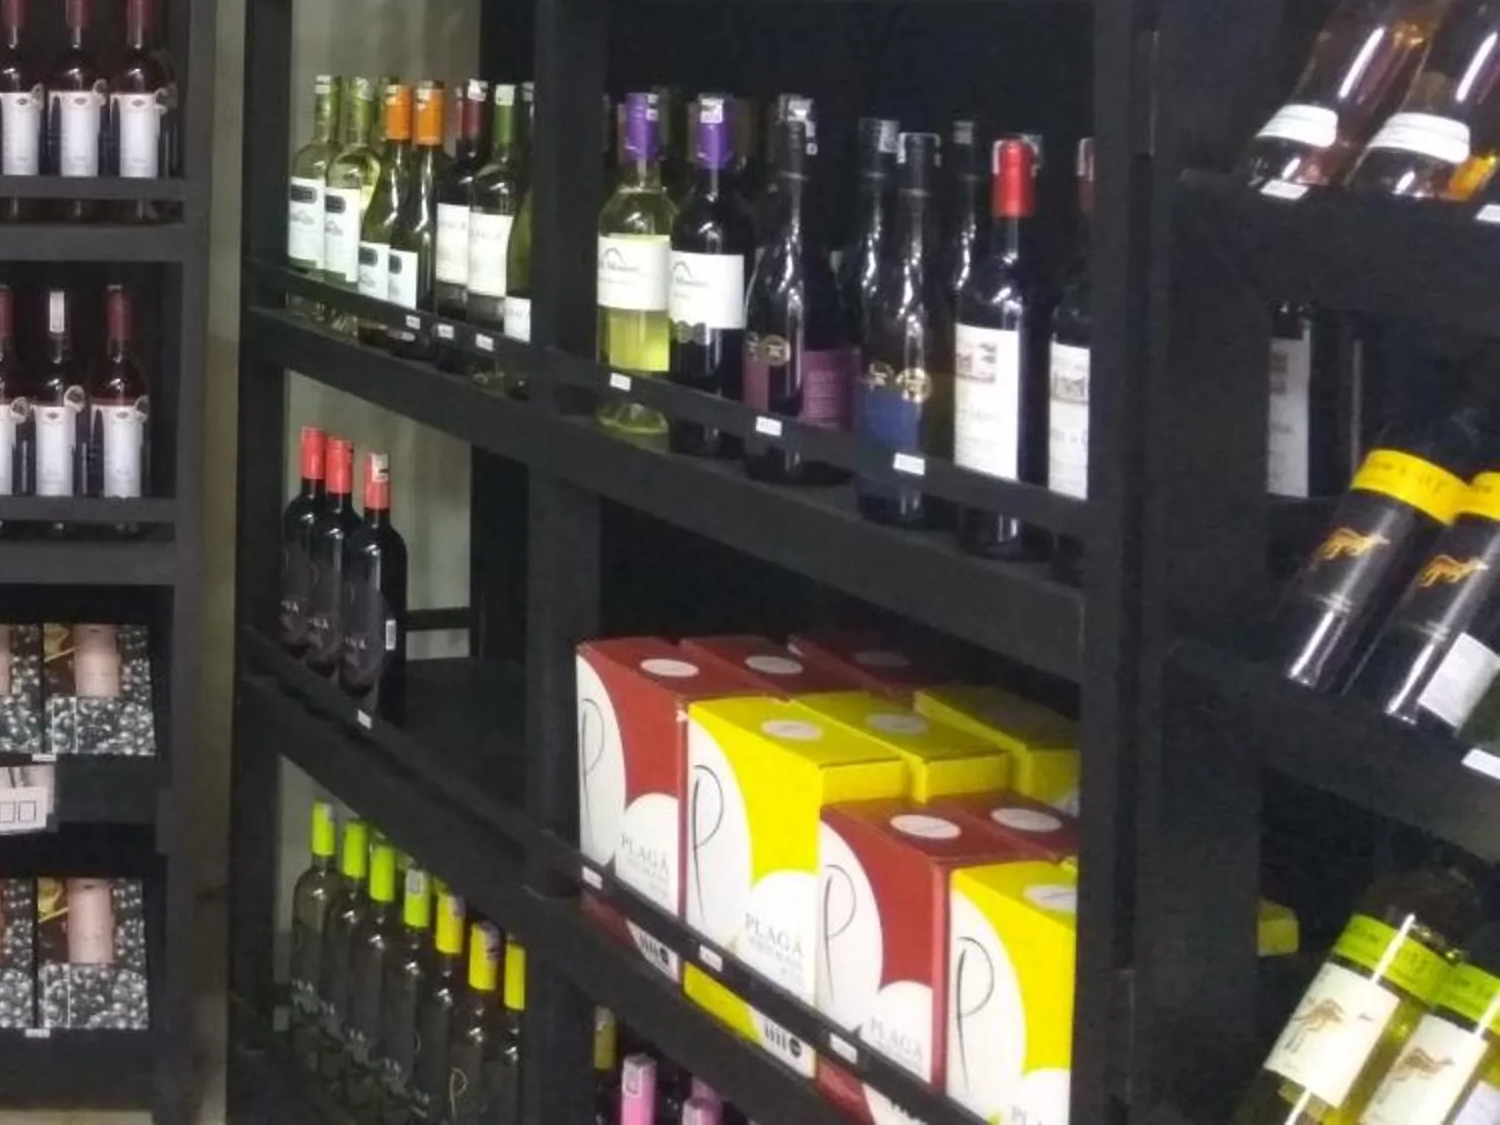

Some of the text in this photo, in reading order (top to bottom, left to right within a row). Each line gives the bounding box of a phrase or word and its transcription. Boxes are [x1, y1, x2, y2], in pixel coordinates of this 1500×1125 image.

[621, 832, 669, 875] PLAGA
[745, 912, 804, 958] PLAGA
[870, 1016, 922, 1056] PLAGA
